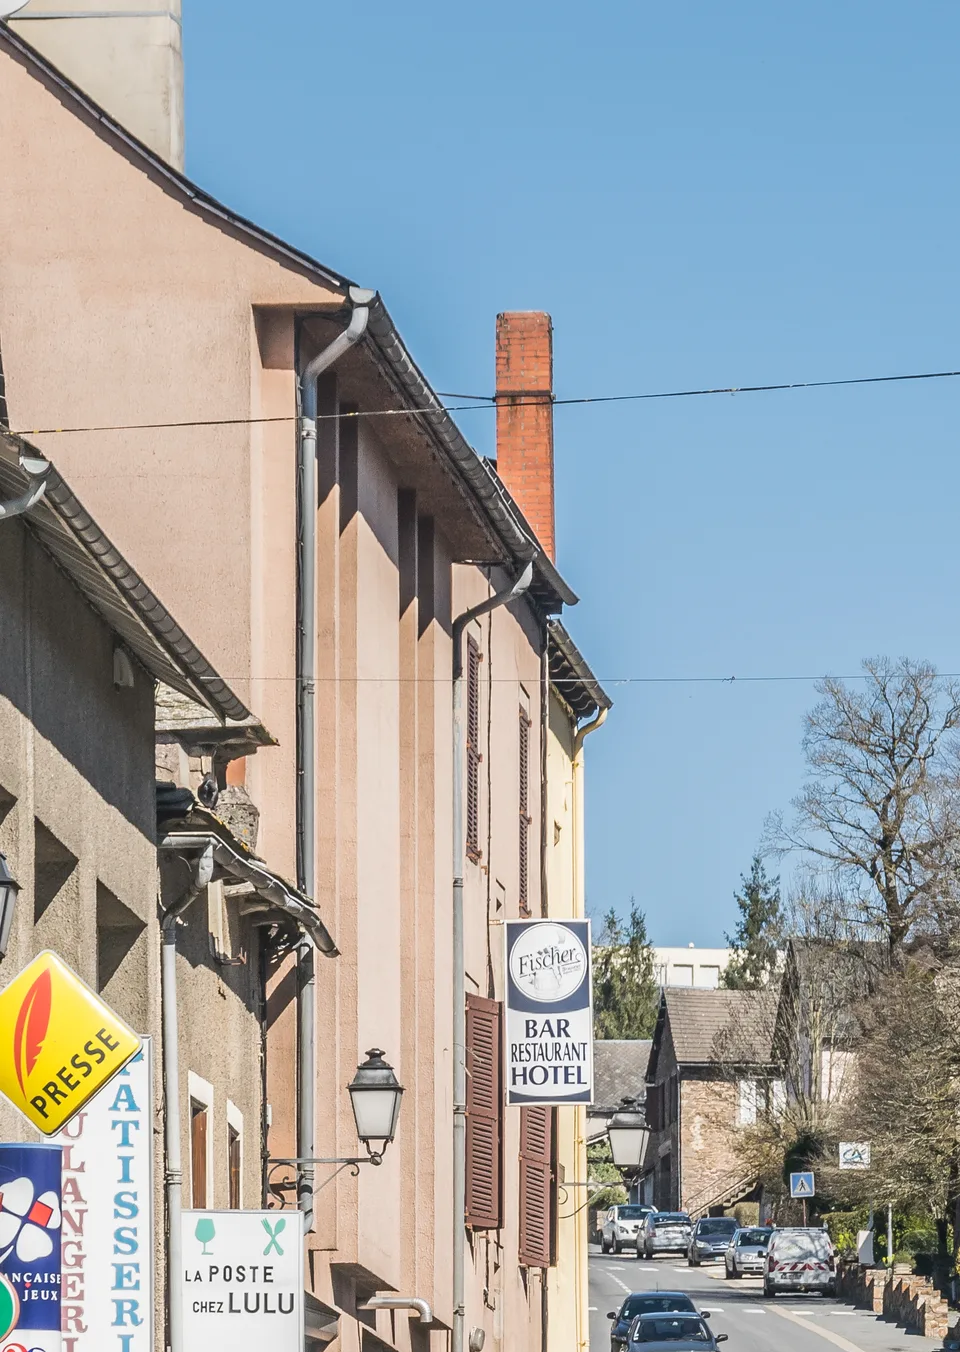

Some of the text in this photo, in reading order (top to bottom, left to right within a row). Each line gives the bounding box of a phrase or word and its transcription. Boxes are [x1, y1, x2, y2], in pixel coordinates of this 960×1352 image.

[518, 947, 577, 975] Fischer
[525, 1019, 571, 1039] BAR
[511, 1042, 588, 1063] RESTAURANT
[29, 1028, 120, 1119] PRESSE
[511, 1065, 588, 1086] HOTEL
[185, 1265, 274, 1283] LA POSTE
[22, 1290, 58, 1301] JEUX
[192, 1292, 294, 1314] CHEZ LULU
